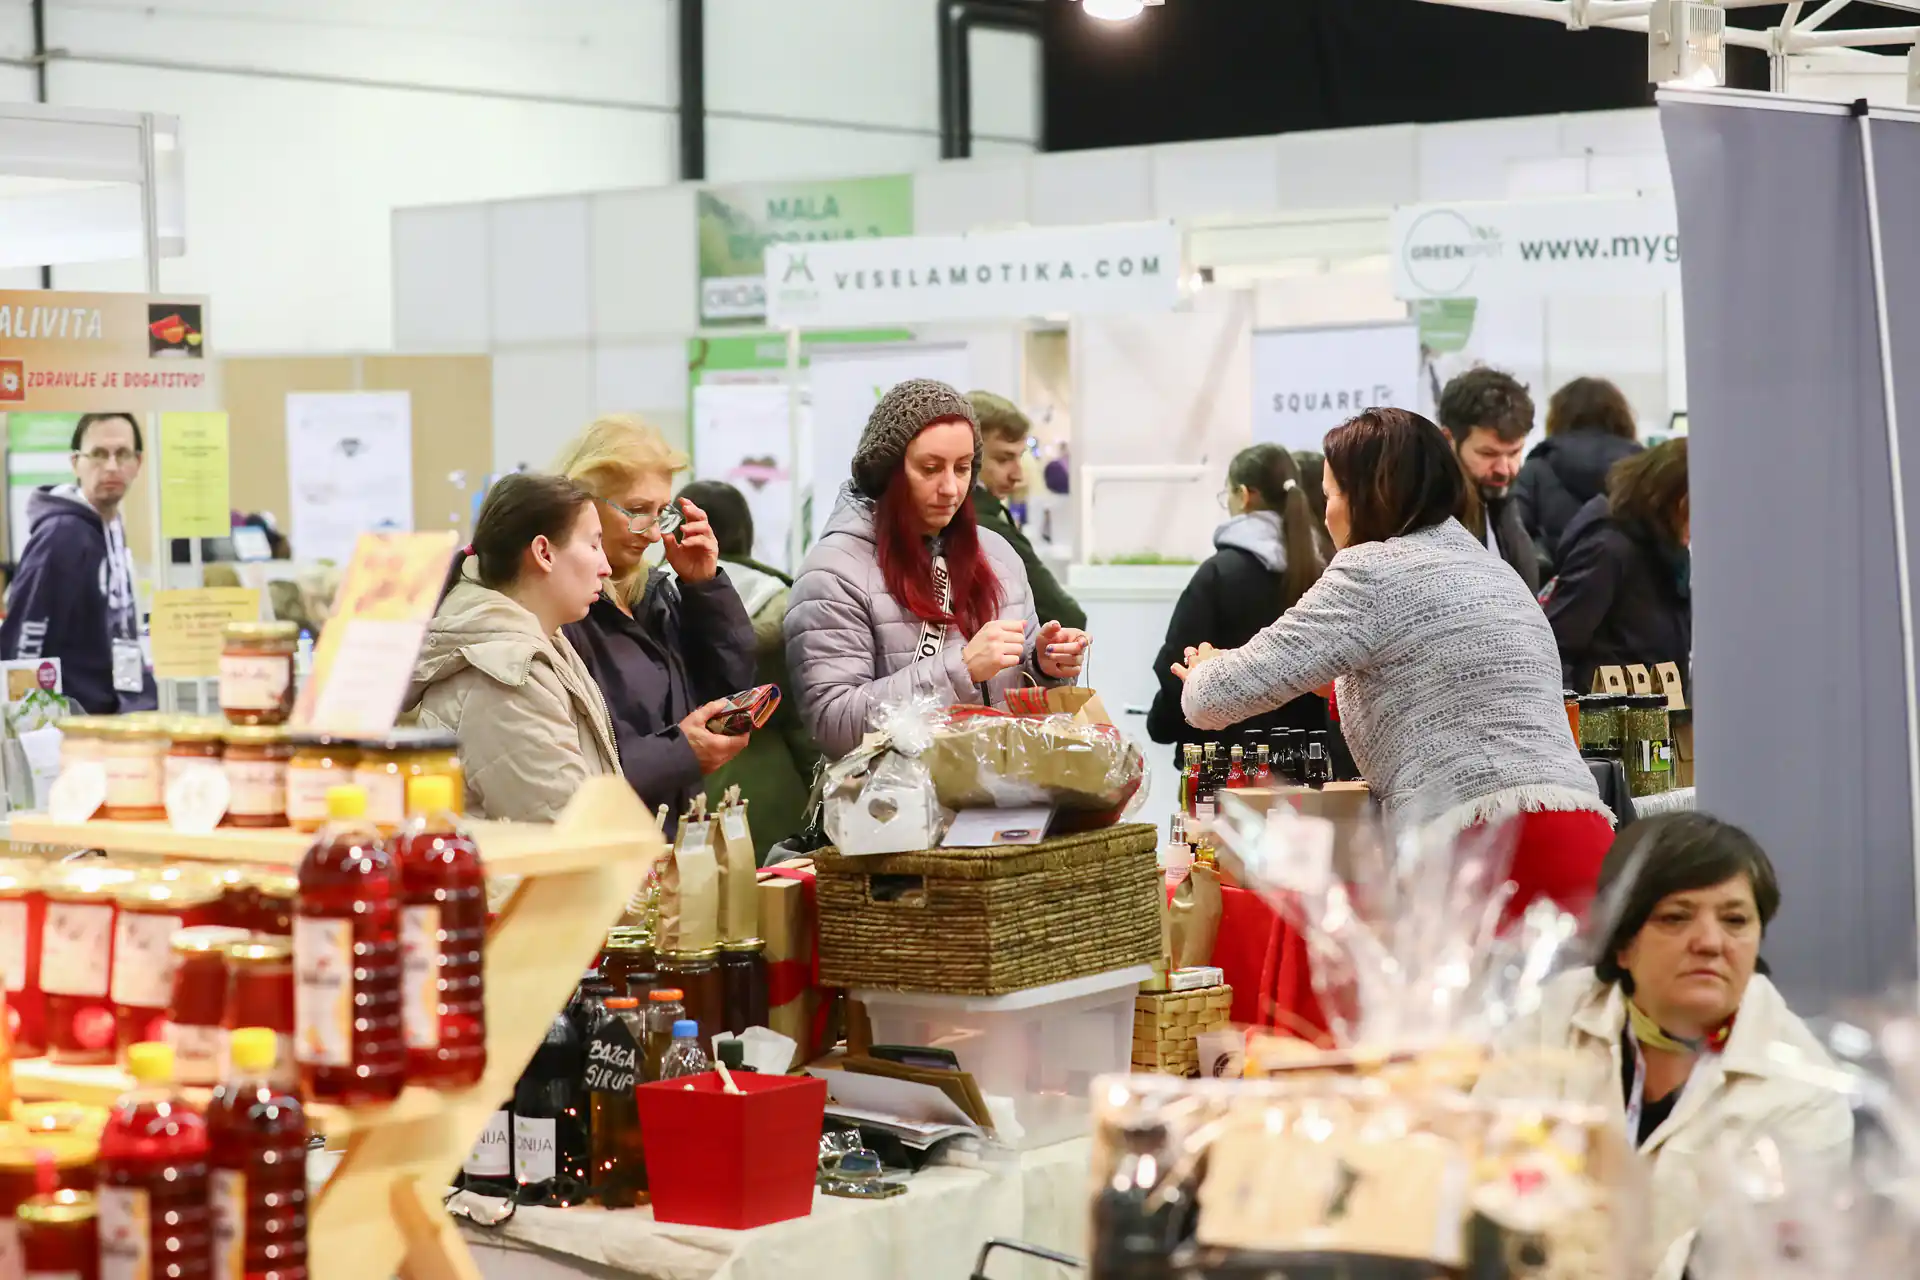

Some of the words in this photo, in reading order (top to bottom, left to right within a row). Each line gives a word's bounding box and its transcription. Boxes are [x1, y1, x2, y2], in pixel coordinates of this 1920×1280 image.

[767, 195, 840, 220] MALA
[835, 256, 1160, 289] VESELAMOTIKA.COM
[27, 371, 97, 388] ZDRAVLJE
[101, 373, 119, 388] JE
[1273, 389, 1363, 413] SQUARE
[589, 1039, 636, 1069] BAZGA
[584, 1064, 634, 1091] SIRUP
